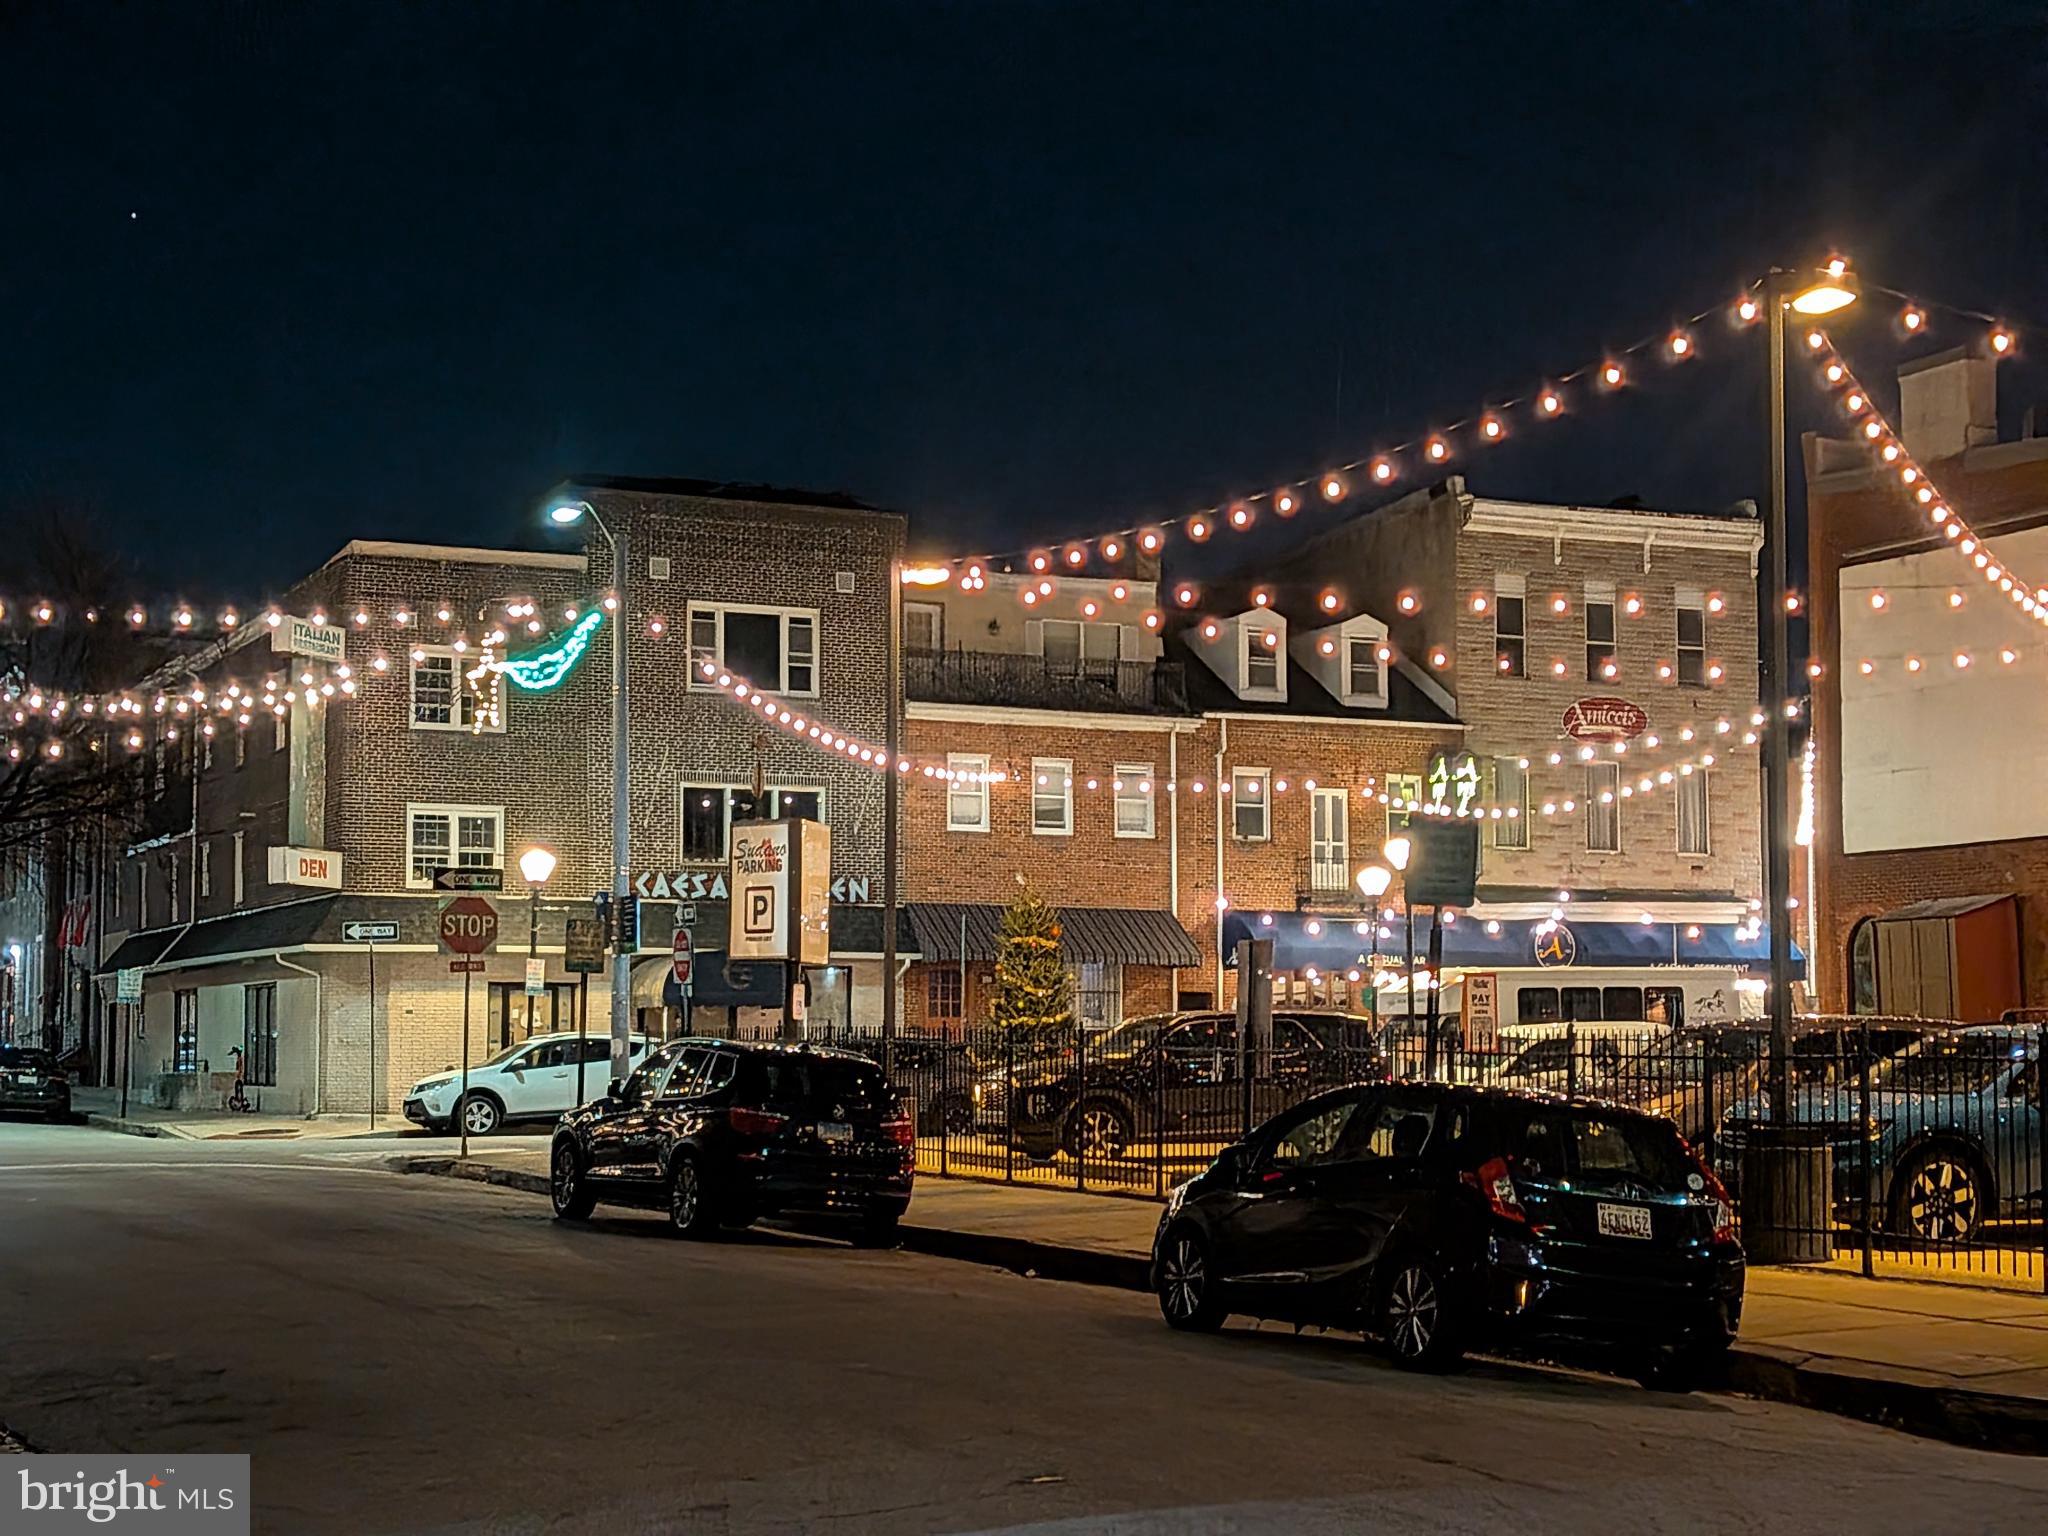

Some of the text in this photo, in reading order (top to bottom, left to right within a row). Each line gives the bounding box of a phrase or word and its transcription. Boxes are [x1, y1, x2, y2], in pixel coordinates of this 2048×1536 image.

[294, 623, 340, 646] ITALIAN
[299, 857, 328, 880] DEN
[736, 859, 783, 875] PARKING
[477, 874, 497, 885] WAY
[635, 871, 870, 903] CAESA EN
[752, 894, 769, 926] P
[443, 914, 496, 937] STOP
[1471, 993, 1491, 1003] PAY
